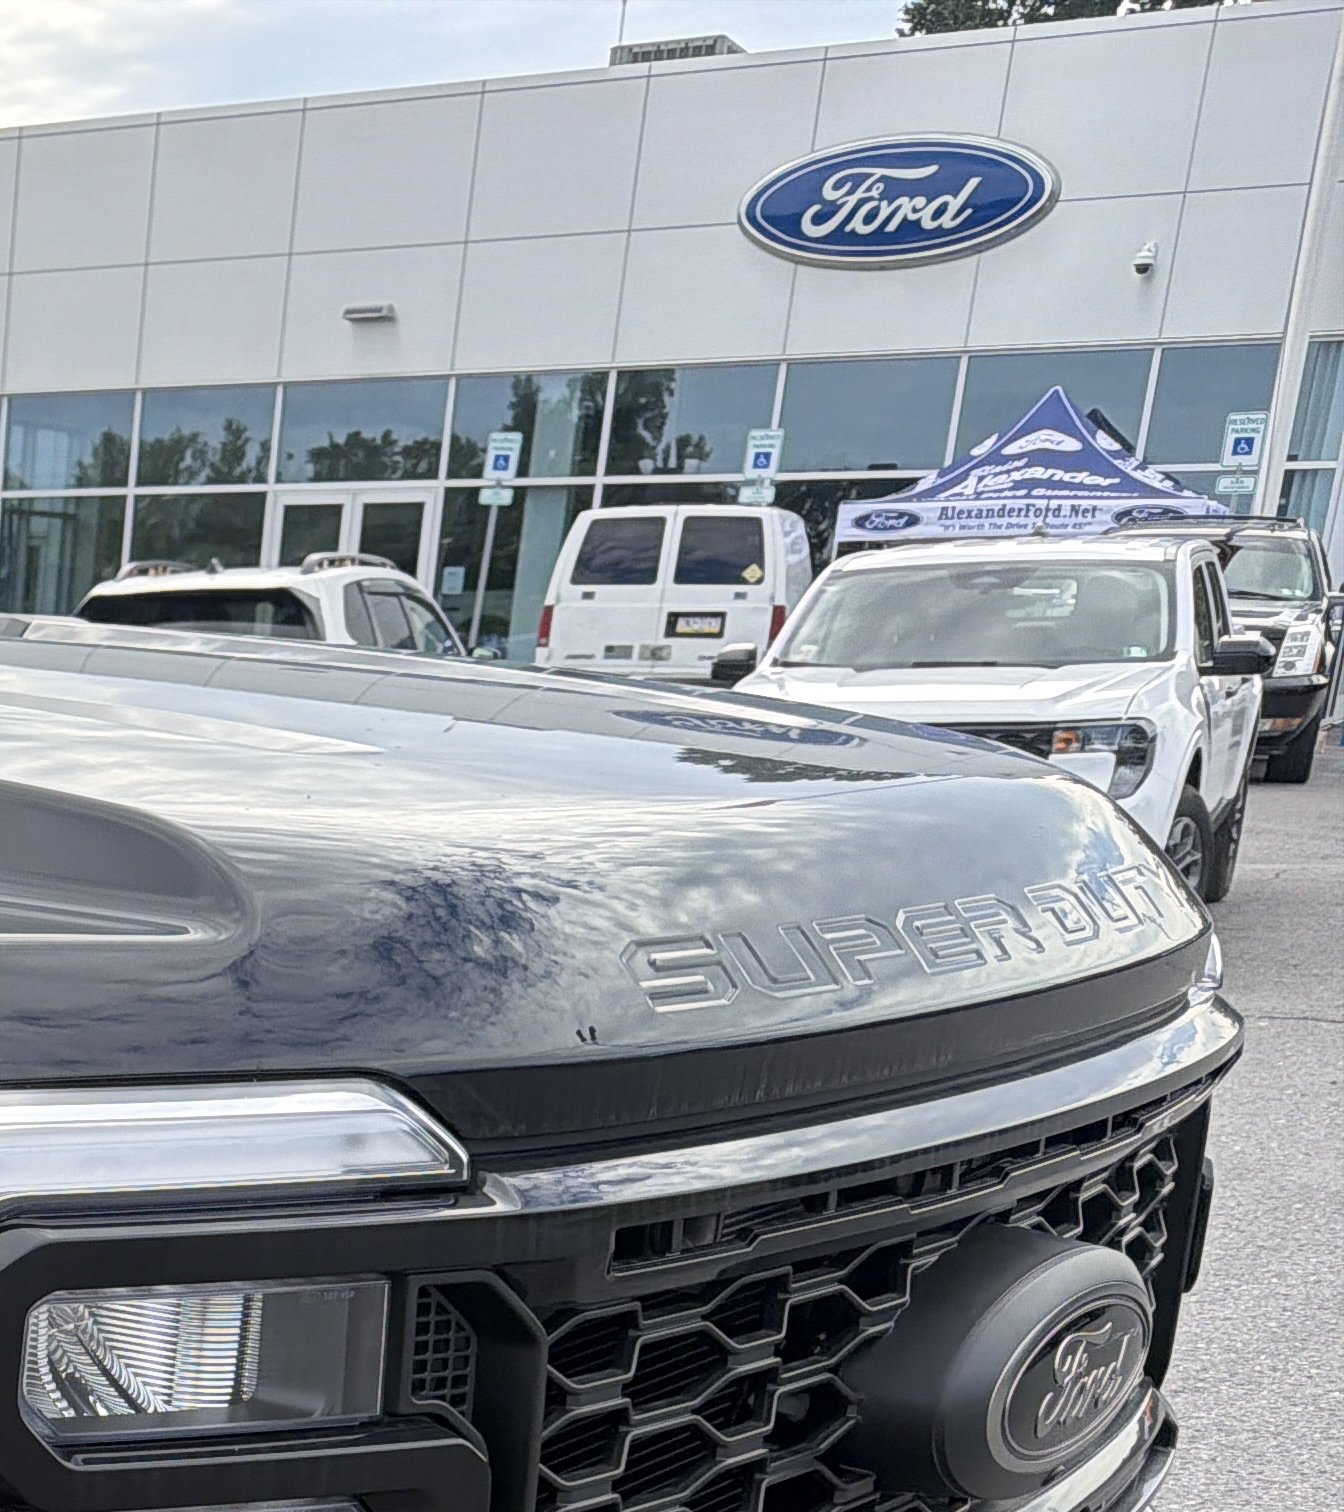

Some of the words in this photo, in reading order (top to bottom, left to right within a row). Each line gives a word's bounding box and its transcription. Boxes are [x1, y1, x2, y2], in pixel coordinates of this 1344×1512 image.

[799, 163, 984, 239] Ford
[1229, 417, 1265, 426] RESERVED
[936, 466, 1121, 497] Alexander
[864, 512, 909, 529] Ford
[937, 503, 1099, 521] AlexanderFord.Net
[619, 893, 1047, 1013] SUPER
[1024, 861, 1187, 947] DUTY
[1034, 1320, 1134, 1440] Ford
